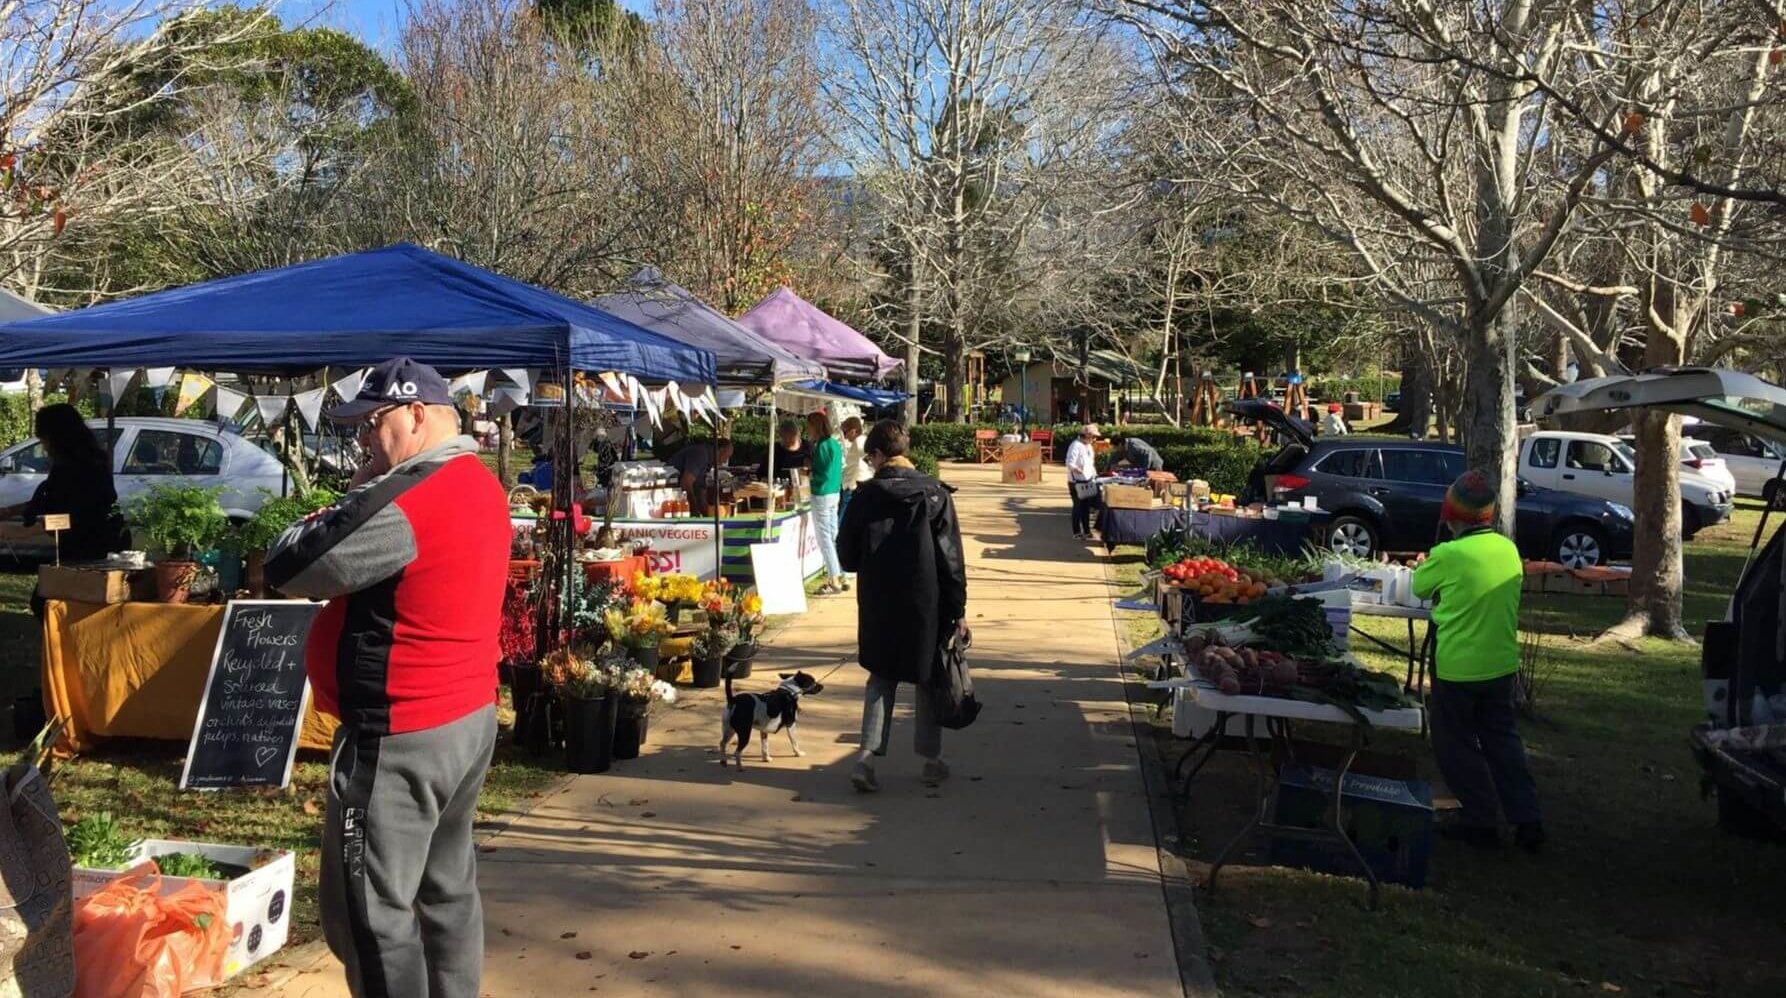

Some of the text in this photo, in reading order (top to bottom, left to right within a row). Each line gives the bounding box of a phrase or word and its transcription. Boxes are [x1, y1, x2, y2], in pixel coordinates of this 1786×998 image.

[386, 381, 418, 396] AO
[658, 529, 709, 541] VEGGIES
[646, 549, 682, 574] SS!
[233, 608, 273, 629] Fresh
[246, 628, 298, 650] Flowers
